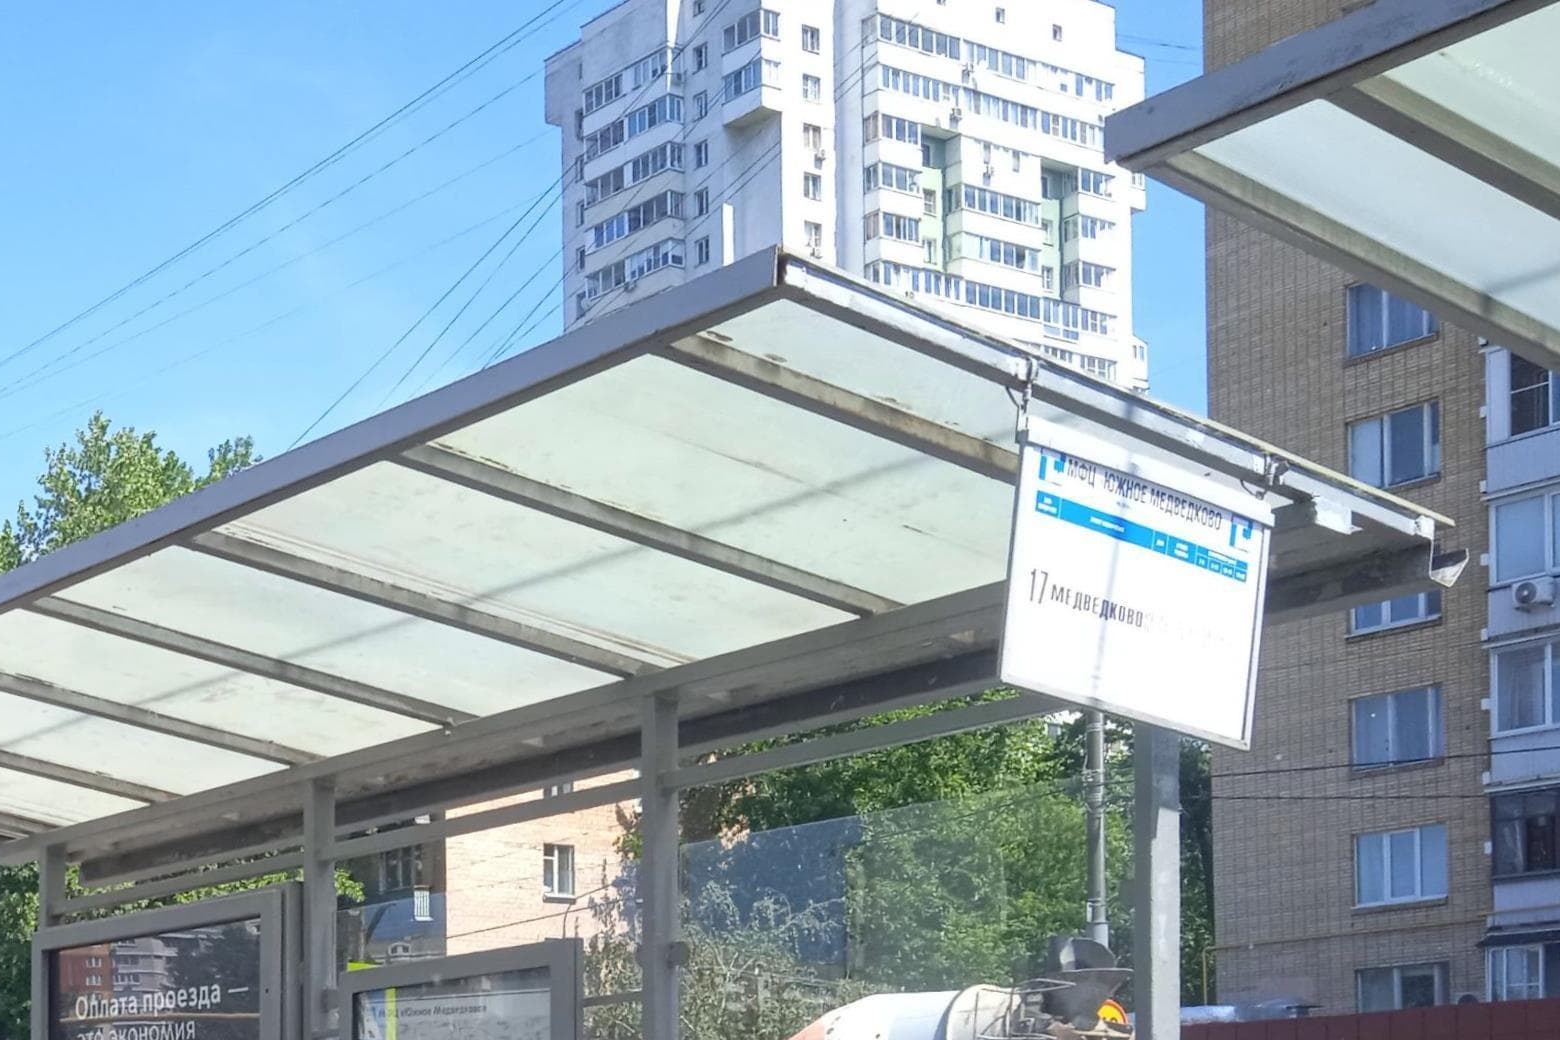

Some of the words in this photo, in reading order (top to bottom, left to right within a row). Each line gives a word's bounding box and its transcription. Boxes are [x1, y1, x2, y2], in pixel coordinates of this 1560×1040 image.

[1067, 458, 1096, 488] МФЦ
[1104, 471, 1148, 504] ЮЖНОЕ
[1149, 487, 1223, 531] МЕДВЕДКОВО
[1029, 568, 1048, 605] 17
[1050, 584, 1144, 628] МЕДВЕДКОВО
[75, 995, 138, 1019] Оплата
[143, 984, 221, 1016] проезда
